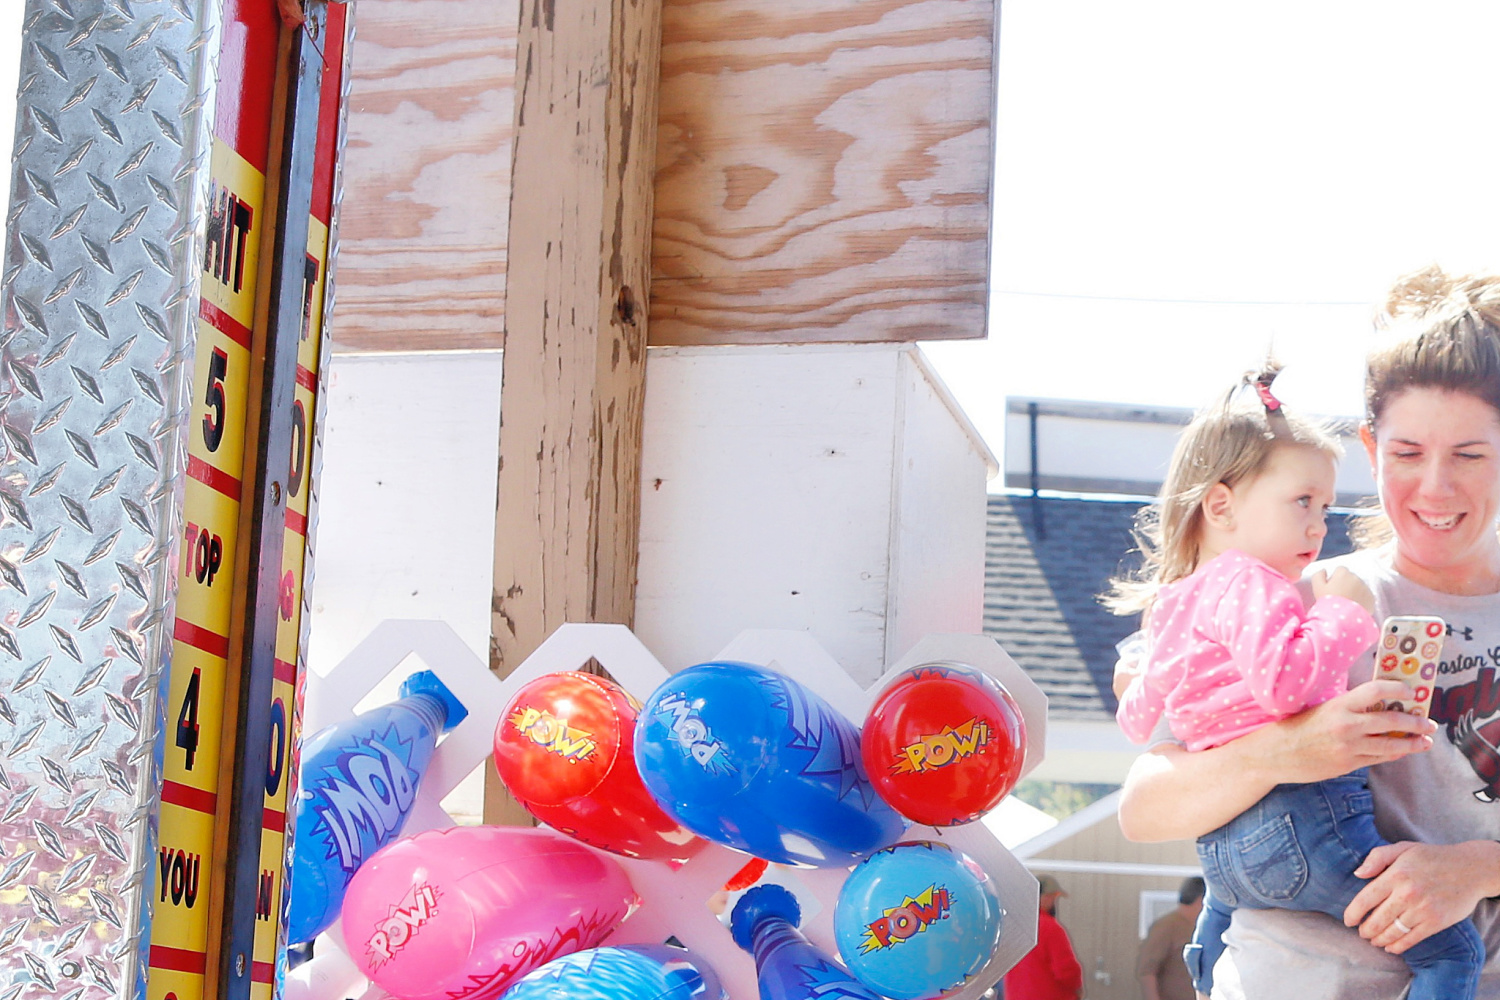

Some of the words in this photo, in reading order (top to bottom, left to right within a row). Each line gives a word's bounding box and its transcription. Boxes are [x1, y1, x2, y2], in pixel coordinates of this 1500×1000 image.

[204, 177, 253, 294] HIT
[202, 345, 227, 452] 5
[185, 522, 223, 587] TOP
[1437, 653, 1487, 675] oston
[176, 667, 201, 771] 4
[518, 706, 597, 765] POW!
[906, 723, 989, 773] POW!
[160, 846, 201, 909] YOU
[369, 886, 440, 961] POW!
[870, 888, 950, 947] POW!
